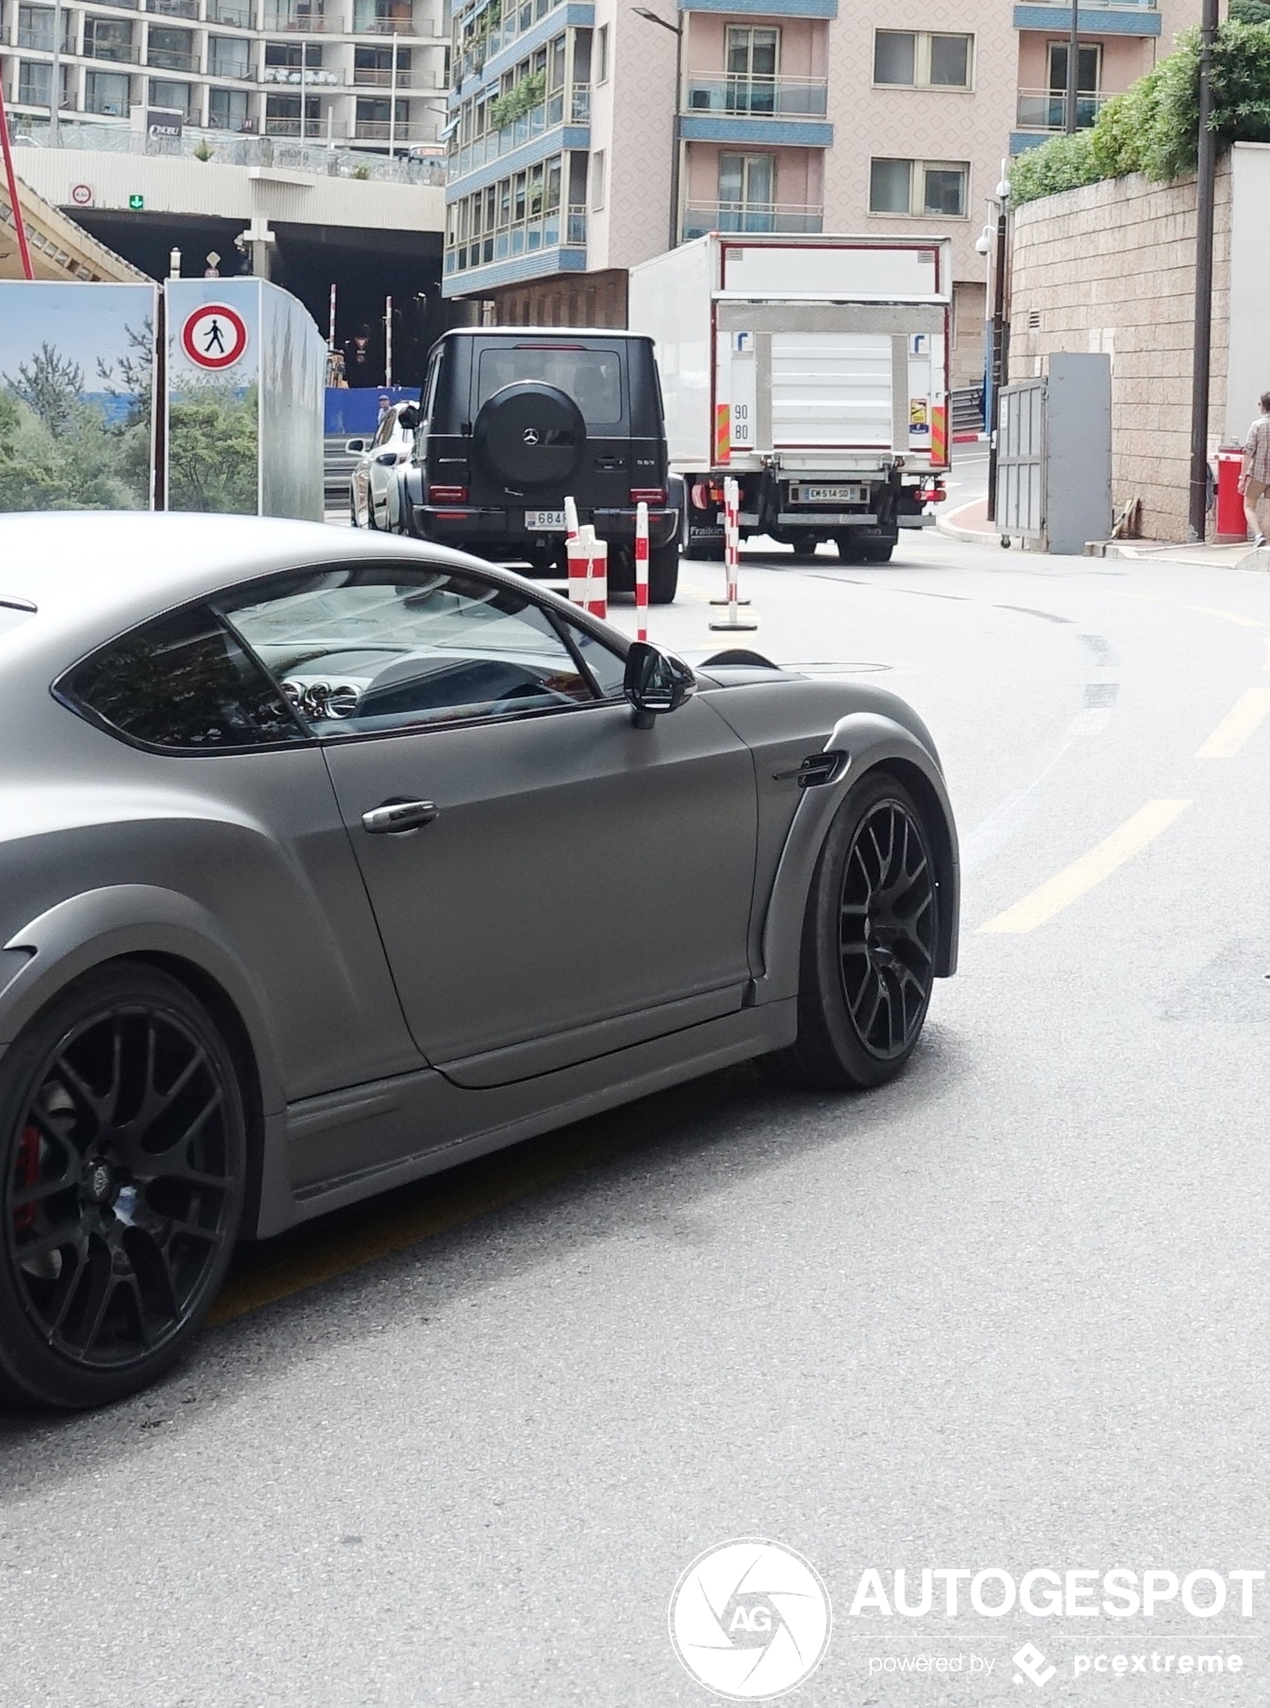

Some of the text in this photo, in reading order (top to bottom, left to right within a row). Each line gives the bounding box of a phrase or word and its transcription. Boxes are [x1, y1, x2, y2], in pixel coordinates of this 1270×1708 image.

[735, 405, 748, 419] 90
[735, 425, 748, 439] 80
[690, 526, 723, 535] Fraikin
